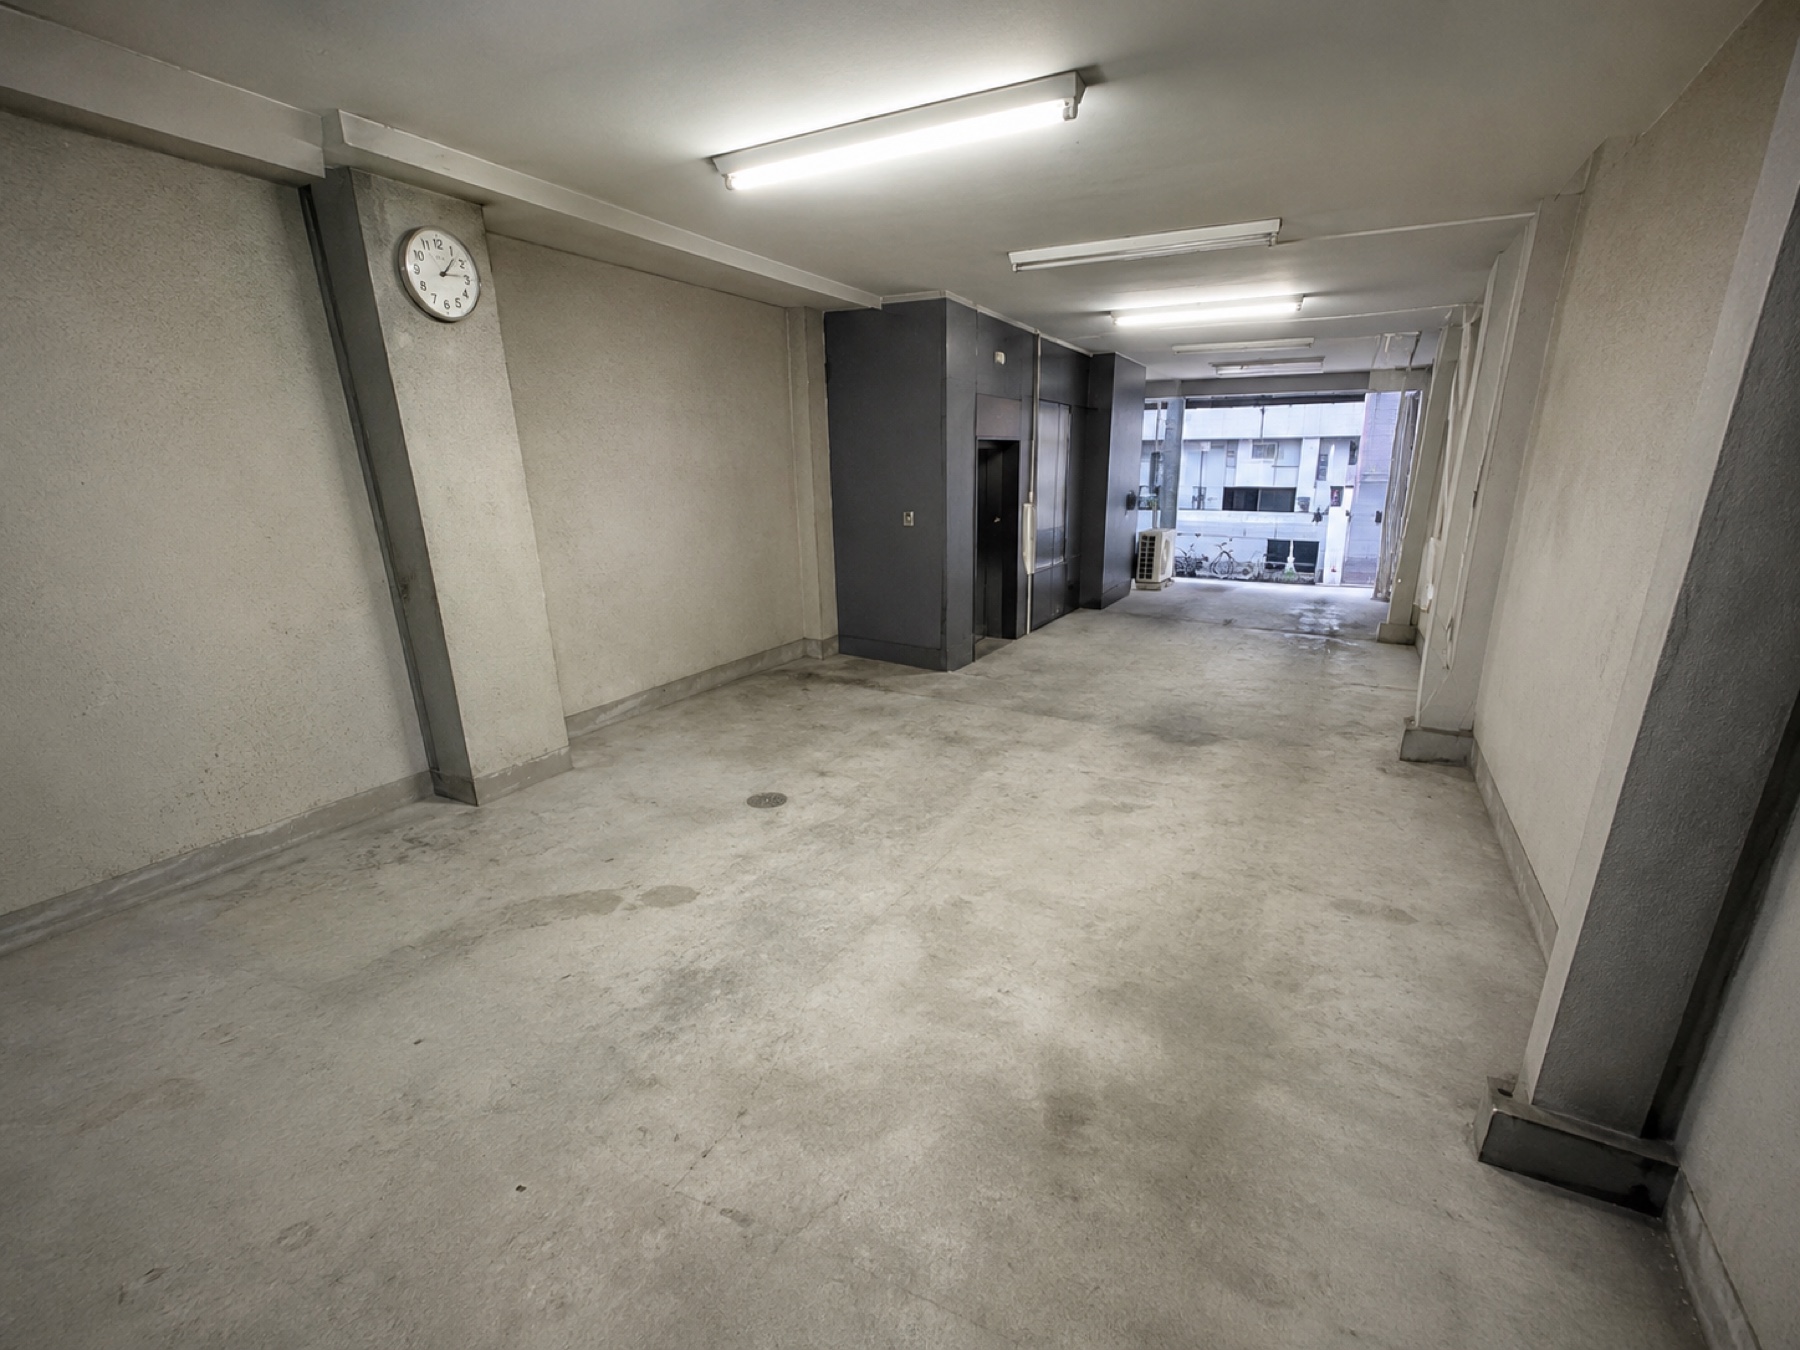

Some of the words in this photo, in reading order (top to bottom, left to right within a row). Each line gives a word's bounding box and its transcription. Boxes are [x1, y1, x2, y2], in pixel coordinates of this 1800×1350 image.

[421, 238, 430, 250] 11
[433, 239, 443, 250] 12
[414, 250, 424, 261] 10
[459, 259, 465, 269] 2
[414, 264, 420, 275] 9
[464, 275, 470, 285] 3
[420, 281, 426, 291] 8
[462, 288, 469, 298] 4
[431, 293, 437, 304] 7
[455, 298, 461, 308] 5
[444, 300, 450, 310] 6
